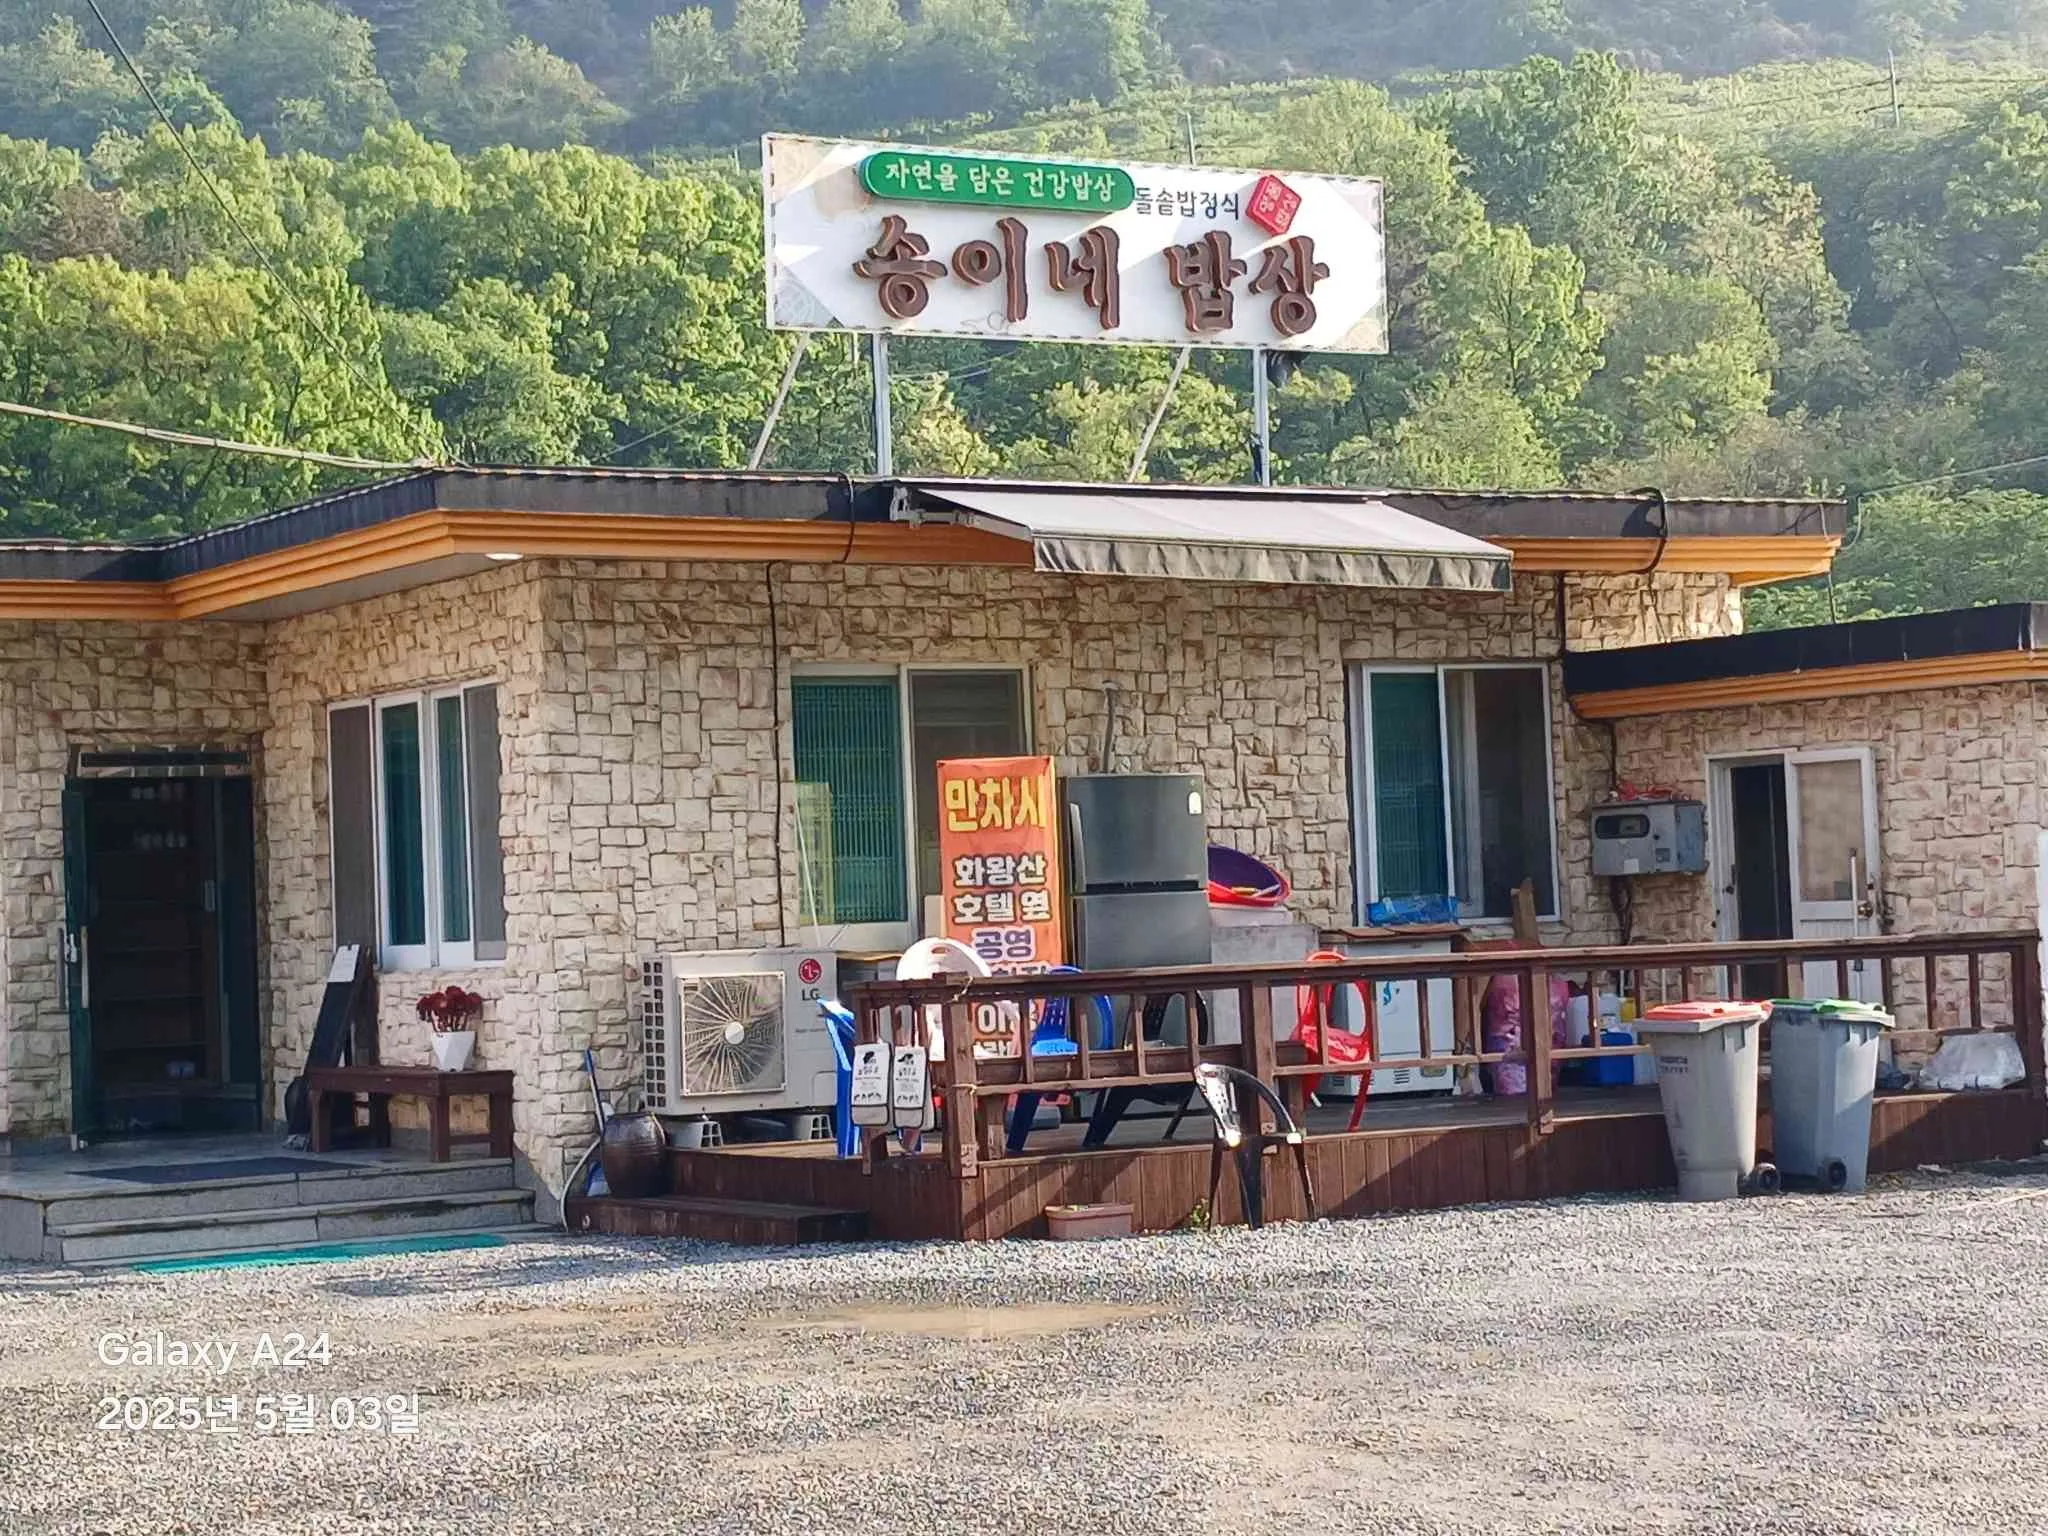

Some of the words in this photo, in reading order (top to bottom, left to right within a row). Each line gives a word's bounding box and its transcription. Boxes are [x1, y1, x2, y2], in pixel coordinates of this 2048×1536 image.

[885, 158, 958, 192] 자연을
[968, 164, 1015, 196] 담은
[1023, 168, 1116, 202] 건강밥상
[1135, 187, 1239, 220] 돌솥밥정식
[853, 214, 1122, 331] 송이네
[1162, 229, 1331, 338] 밥상
[944, 775, 1048, 832] 만차시
[954, 855, 1047, 887] 화왕산
[952, 892, 1016, 924] 호텔
[1020, 888, 1051, 921] 옆
[974, 927, 1034, 960] 공영
[801, 988, 821, 1001] LG
